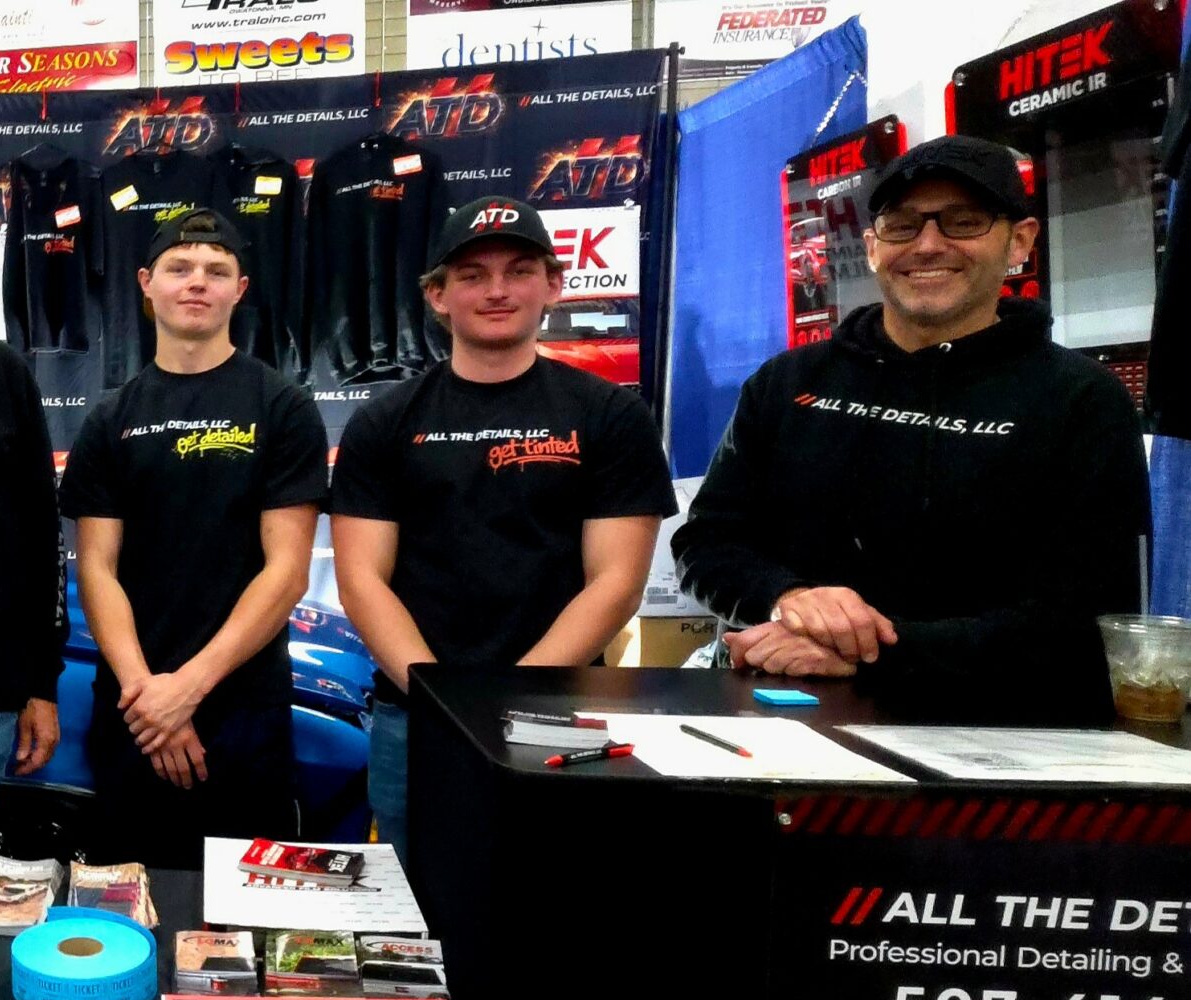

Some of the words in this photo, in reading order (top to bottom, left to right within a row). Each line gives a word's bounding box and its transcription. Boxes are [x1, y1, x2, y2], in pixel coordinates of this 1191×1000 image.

[191, 12, 326, 31] www.traloinc.com
[717, 7, 828, 31] FEDERATED
[713, 28, 789, 44] INSURANCE
[17, 49, 121, 75] SEASONS
[165, 31, 354, 75] Sweets
[442, 33, 598, 69] dentists
[999, 20, 1114, 101] HITEK
[531, 94, 554, 105] ALL
[556, 92, 580, 103] THE
[582, 88, 634, 101] DETAILS,
[636, 85, 658, 97] LLC
[1009, 79, 1085, 117] CERAMIC
[1088, 71, 1107, 90] IR
[248, 116, 270, 126] ALL
[272, 114, 295, 125] THE
[296, 111, 346, 123] DETAILS,
[347, 108, 370, 120] LLC
[388, 92, 504, 138] ATD
[15, 123, 61, 135] DETAILS,
[63, 123, 83, 134] LLC
[102, 113, 214, 156] ATD
[809, 136, 868, 177] HITEK
[489, 167, 512, 179] LLC
[528, 152, 649, 201] ATD
[470, 207, 520, 230] ATD
[65, 396, 86, 406] LLC
[348, 390, 371, 400] LLC
[130, 425, 149, 437] ALL
[167, 419, 209, 430] DETAILS,
[210, 419, 231, 429] LLC
[812, 398, 841, 412] ALL
[846, 402, 882, 418] THE
[972, 420, 1015, 435] LLC
[177, 431, 201, 454] get
[200, 423, 257, 445] detailed
[425, 432, 448, 442] ALL
[450, 431, 474, 442] THE
[475, 429, 524, 441] DETAILS,
[525, 428, 550, 438] LLC
[489, 440, 521, 469] get
[522, 430, 580, 455] tinted
[882, 892, 976, 927] ALL
[996, 895, 1095, 931] THE
[381, 942, 435, 956] ACCESS
[829, 940, 1006, 968] Professional
[1017, 946, 1152, 978] Detailing
[1163, 952, 1183, 974] &
[38, 978, 62, 993] TICKET
[73, 984, 100, 996] TICKET
